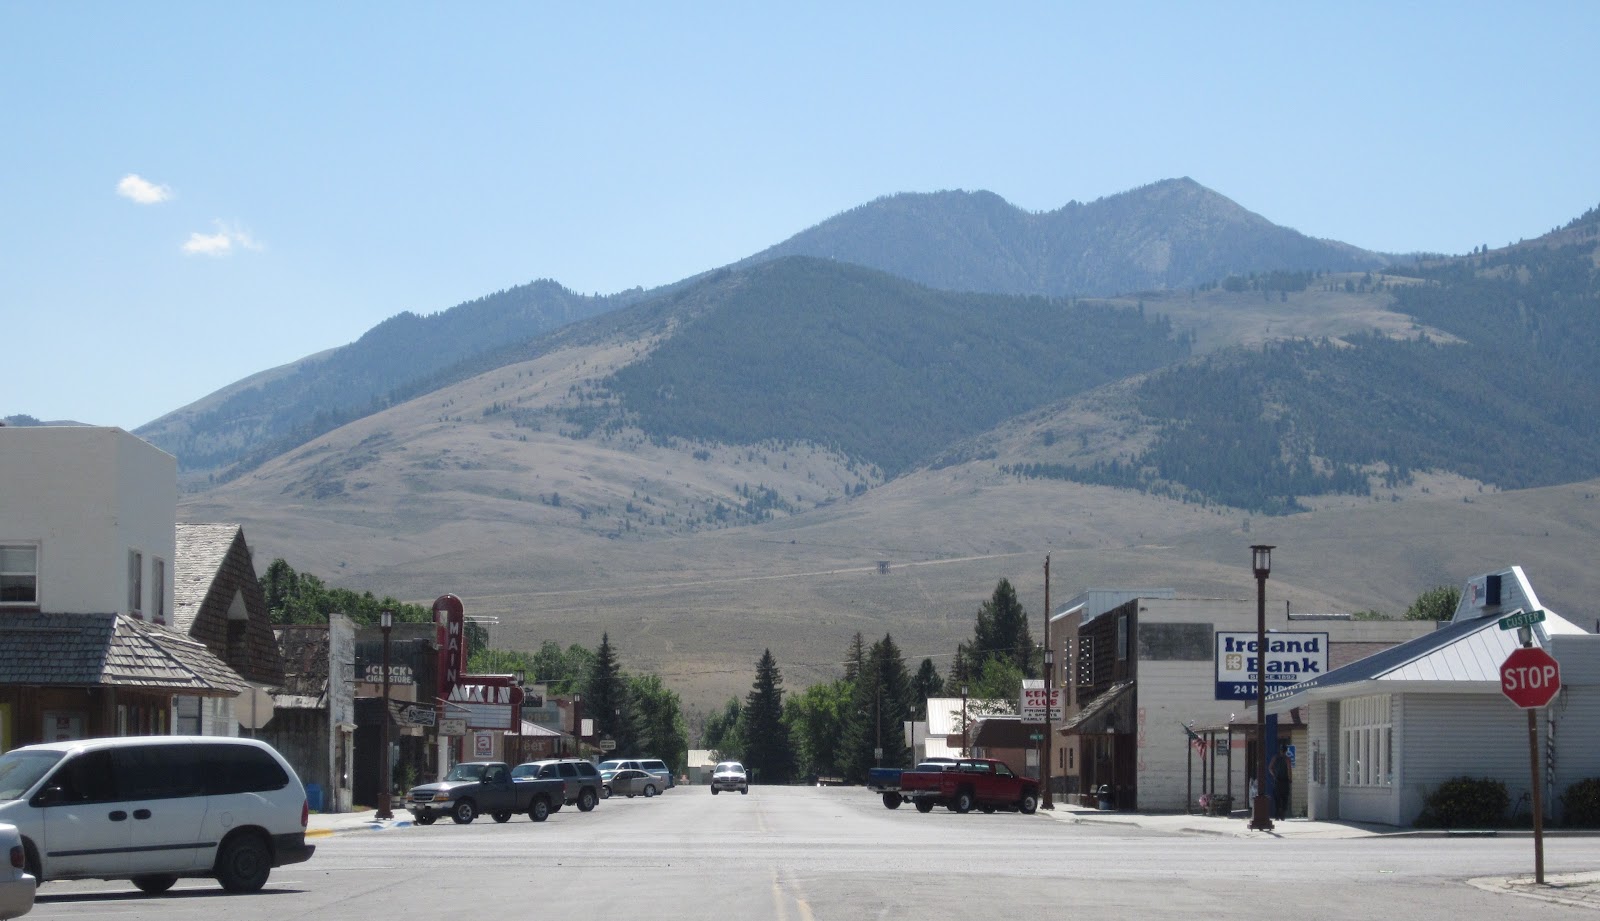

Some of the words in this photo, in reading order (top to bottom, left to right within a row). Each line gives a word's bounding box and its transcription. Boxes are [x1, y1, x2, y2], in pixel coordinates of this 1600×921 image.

[1506, 612, 1540, 628] CUSTER
[447, 621, 459, 682] MAIN
[1225, 637, 1319, 652] Ireland
[1246, 657, 1320, 673] Bank
[366, 675, 388, 683] CIGA
[389, 675, 412, 684] STORE
[1504, 665, 1556, 690] STOP
[447, 684, 511, 704] MAIN
[1234, 685, 1248, 694] 24
